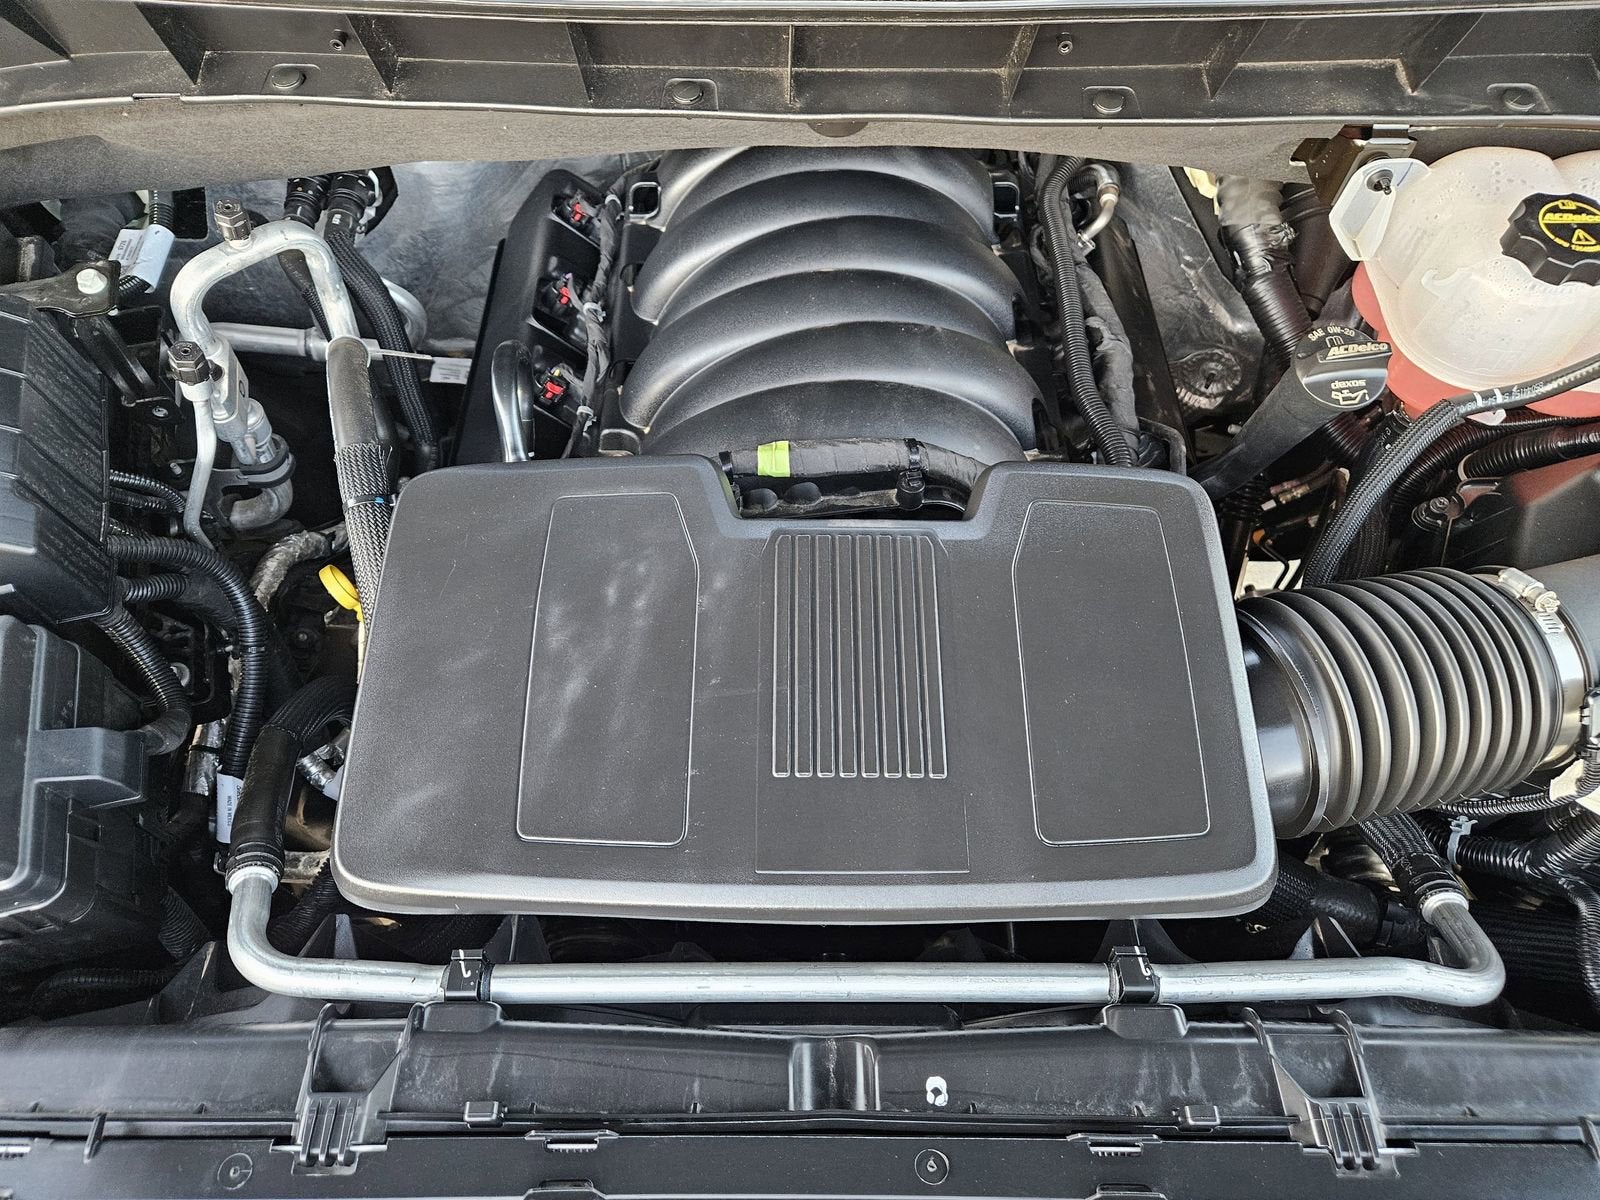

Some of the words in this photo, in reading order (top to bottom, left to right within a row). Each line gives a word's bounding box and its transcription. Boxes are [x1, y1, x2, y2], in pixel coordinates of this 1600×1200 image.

[1308, 328, 1325, 341] SAE
[1327, 325, 1356, 337] 0W-20
[1327, 342, 1388, 357] ACDelco
[1331, 379, 1367, 389] dexos
